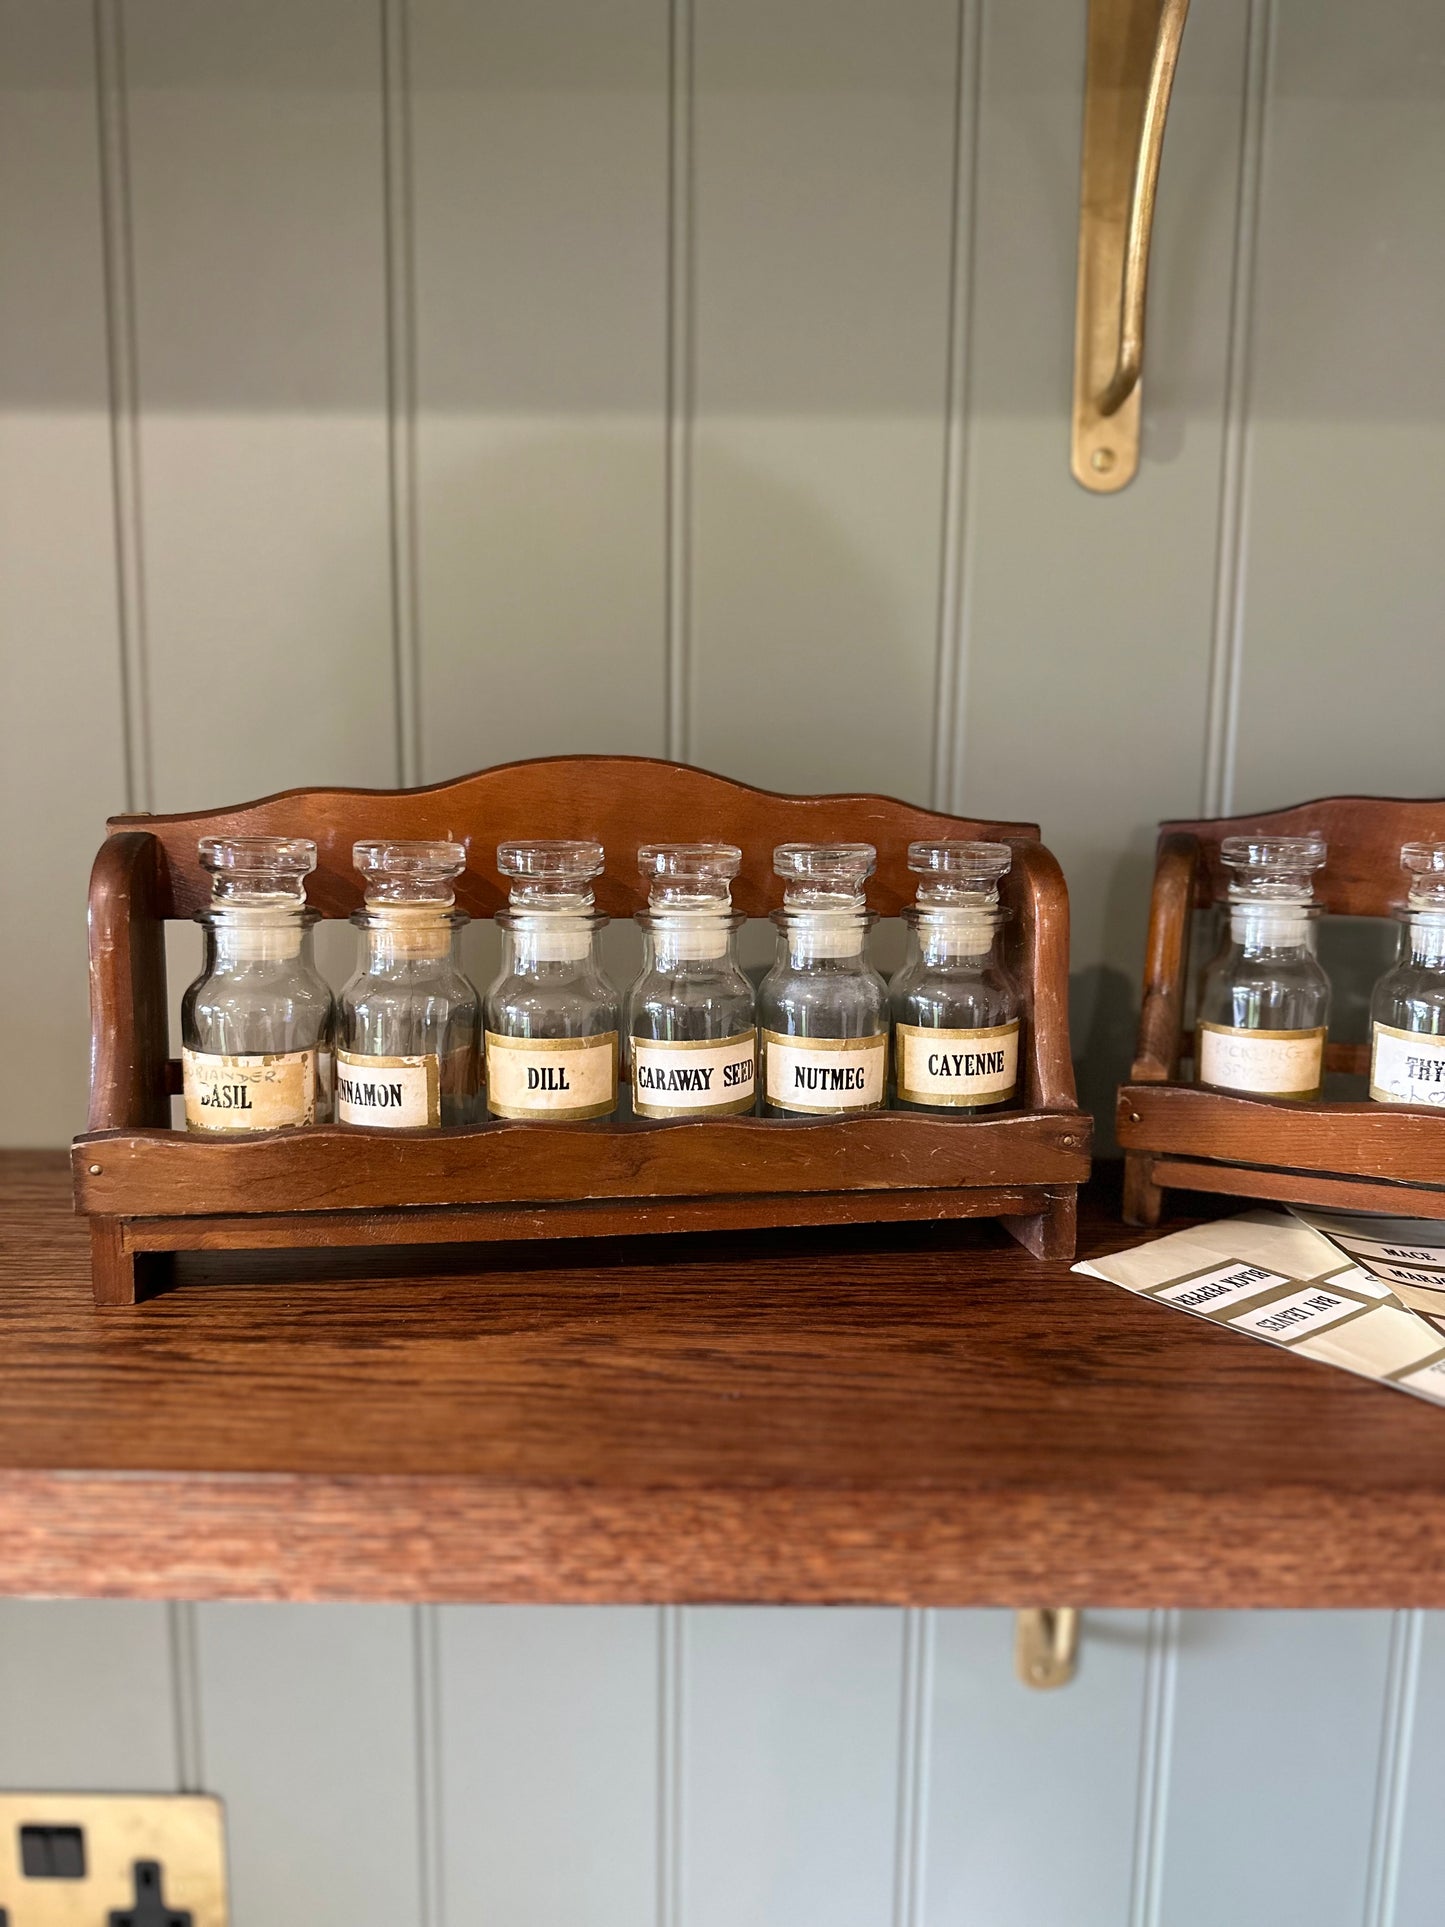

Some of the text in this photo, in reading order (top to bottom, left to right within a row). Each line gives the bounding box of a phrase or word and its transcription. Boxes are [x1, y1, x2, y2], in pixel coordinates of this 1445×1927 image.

[638, 1058, 754, 1091] CARAWAY SEED
[928, 1050, 1005, 1077] CAYENNE
[527, 1067, 570, 1091] DILL
[794, 1066, 865, 1091] NUTMEG
[1381, 1247, 1437, 1261] MACE
[1171, 1268, 1271, 1305] BLACK PEPPER
[1255, 1295, 1342, 1332] BAY LEAVES
